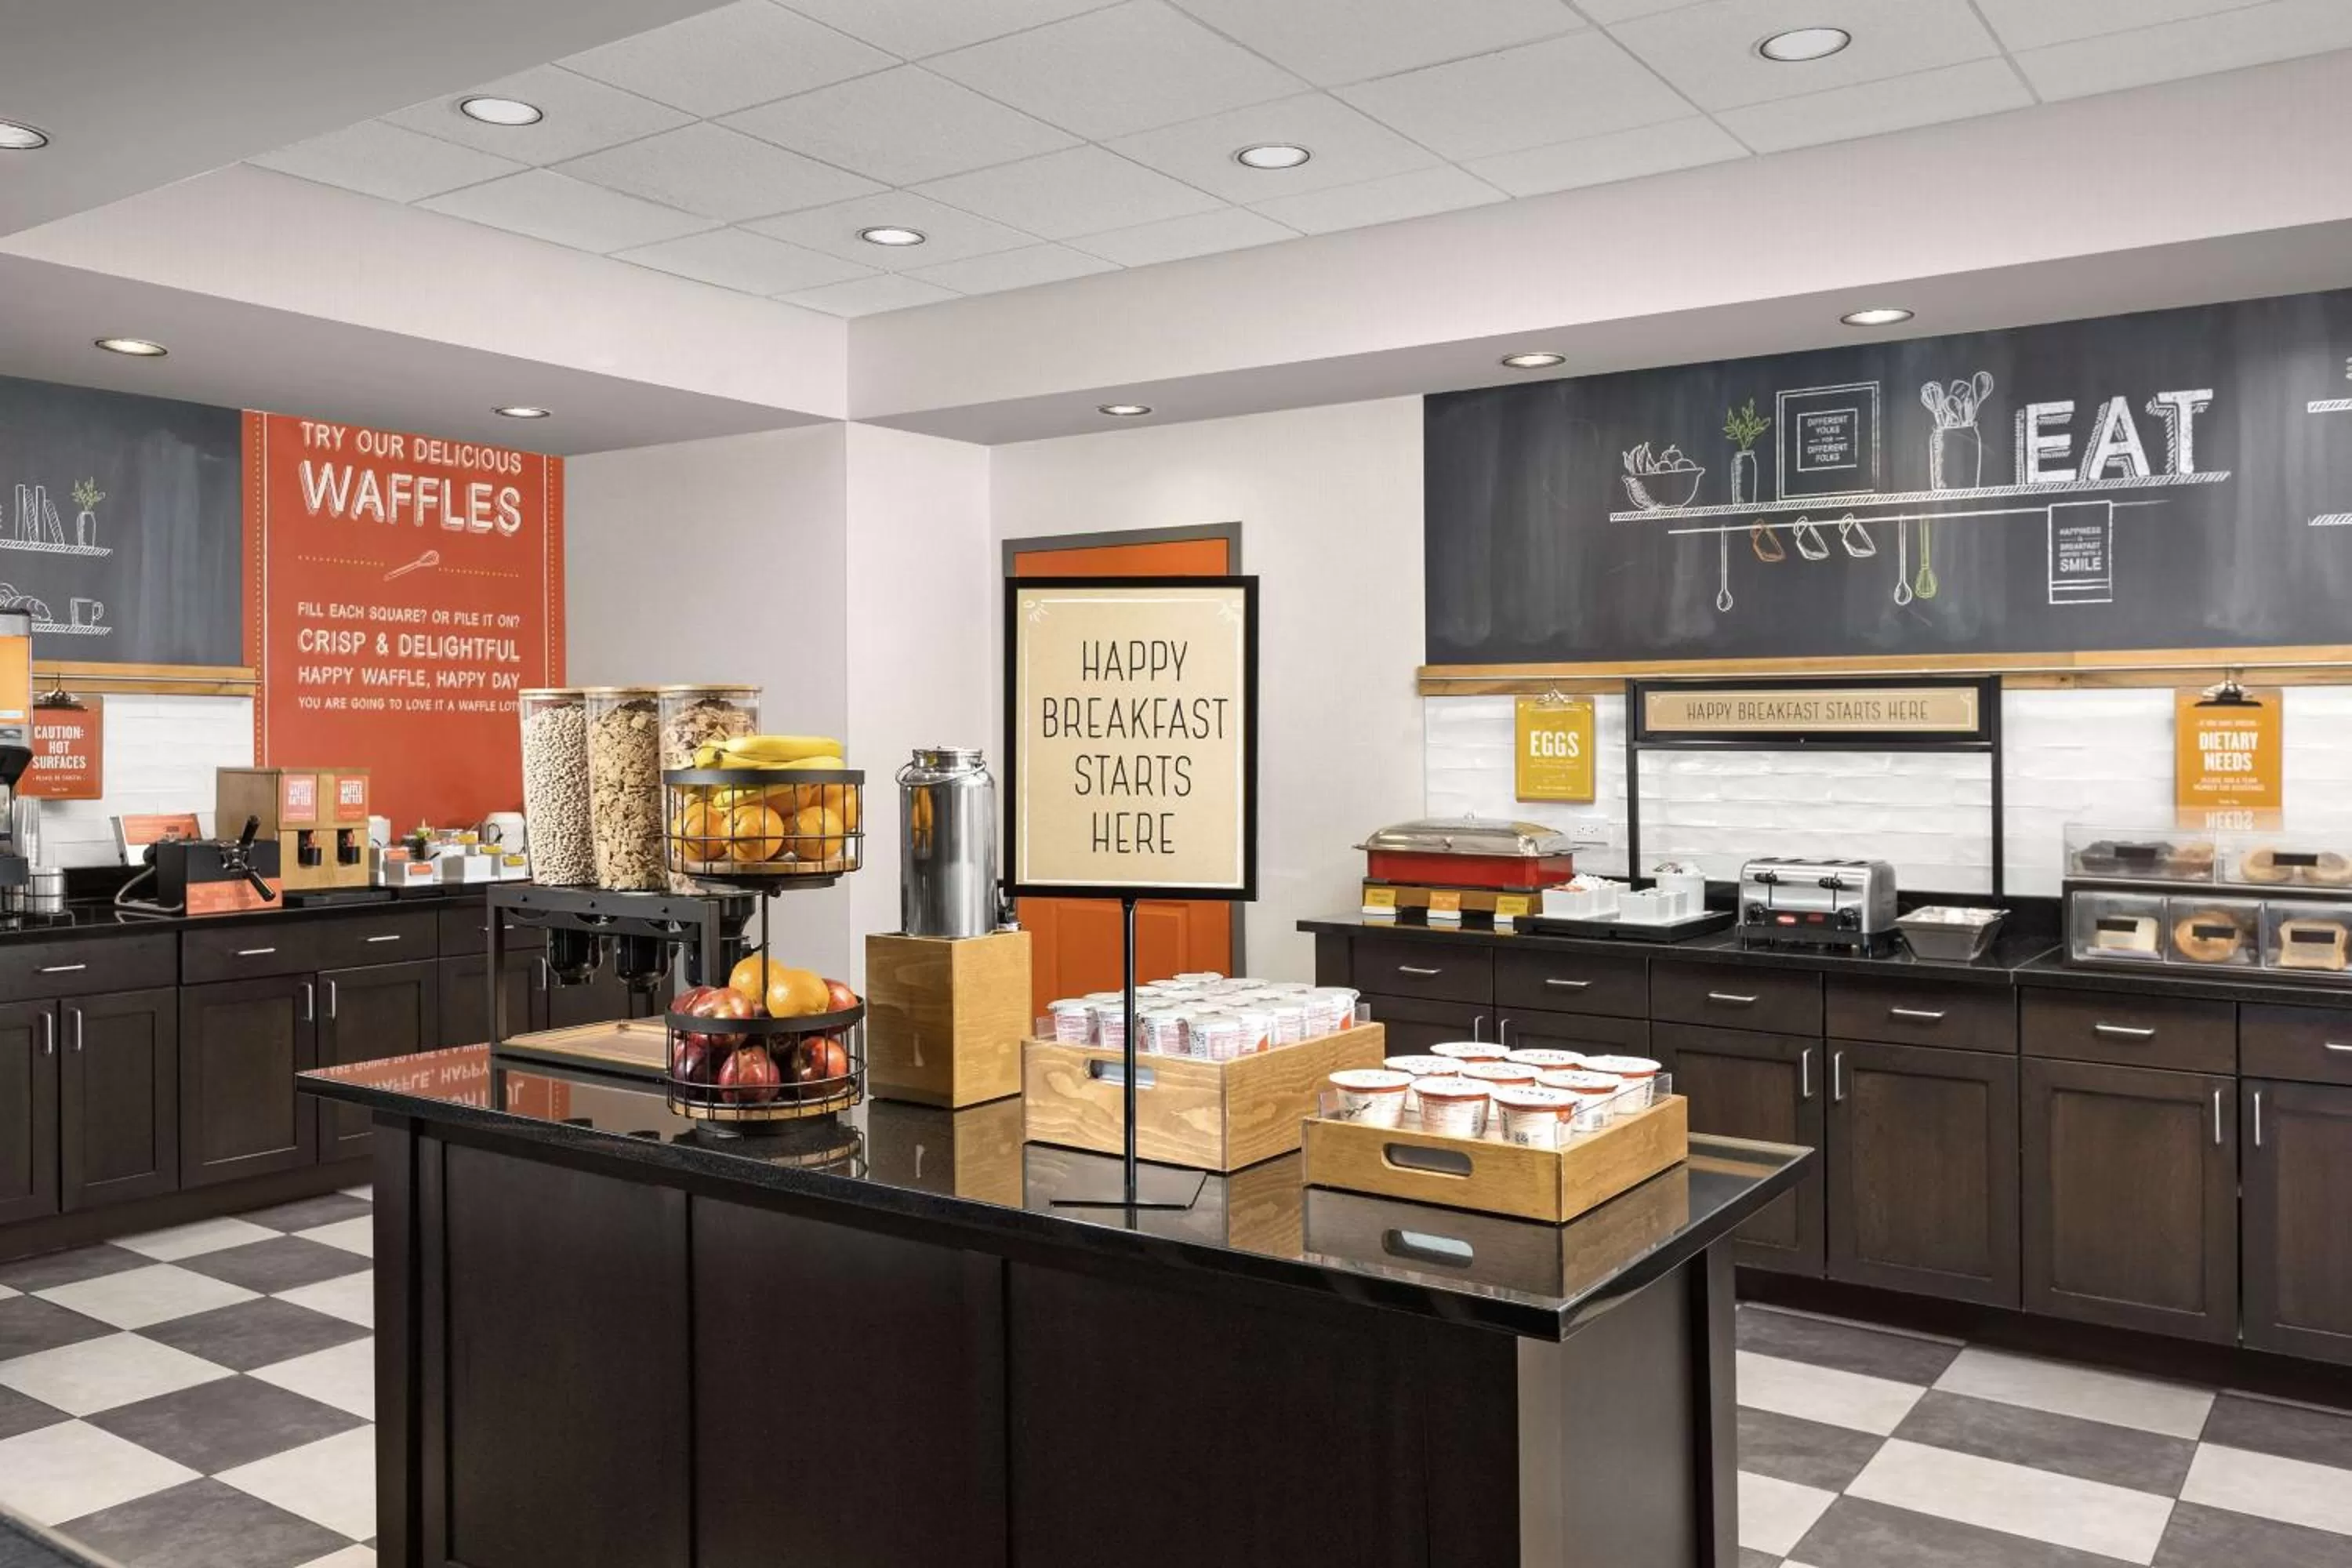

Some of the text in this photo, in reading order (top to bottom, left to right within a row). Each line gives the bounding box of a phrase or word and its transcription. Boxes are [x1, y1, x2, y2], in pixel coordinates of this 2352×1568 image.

[1807, 415, 1849, 427] DIFFERENT
[300, 421, 521, 475] TRY OUR DELICIOUS
[1807, 442, 1849, 454] DIFFERENT
[2016, 389, 2213, 485] EAT
[1815, 452, 1840, 463] FOLKS
[298, 459, 521, 537] WAFFLES
[2059, 556, 2102, 572] SMILE
[298, 601, 521, 628] FILL EACH SQUARE? OR PILE IT ON?
[298, 628, 521, 662] CRISP & DELIGHTFUL
[1082, 640, 1188, 681] HAPPY
[298, 665, 520, 690] HAPPY WAFFLE, HAPPY DAY
[298, 695, 321, 710] YOU
[325, 696, 347, 710] ARE
[350, 697, 384, 711] GOING
[389, 698, 402, 710] TO
[405, 699, 432, 711] LOVE
[435, 699, 445, 711] IT
[448, 699, 455, 711] A
[459, 700, 496, 712] WAFFLE
[1686, 700, 1930, 721] HAPPY BREAKFAST STARTS HERE
[1043, 696, 1229, 739] BREAKFAST
[34, 725, 85, 739] CAUTION:
[1530, 730, 1580, 757] EGGS
[2198, 731, 2259, 750] DIETARY
[49, 740, 70, 754] HOT
[32, 755, 87, 769] SURFACES
[2204, 752, 2252, 771] NEEDS
[1074, 754, 1192, 797] STARTS
[1093, 811, 1176, 854] HERE
